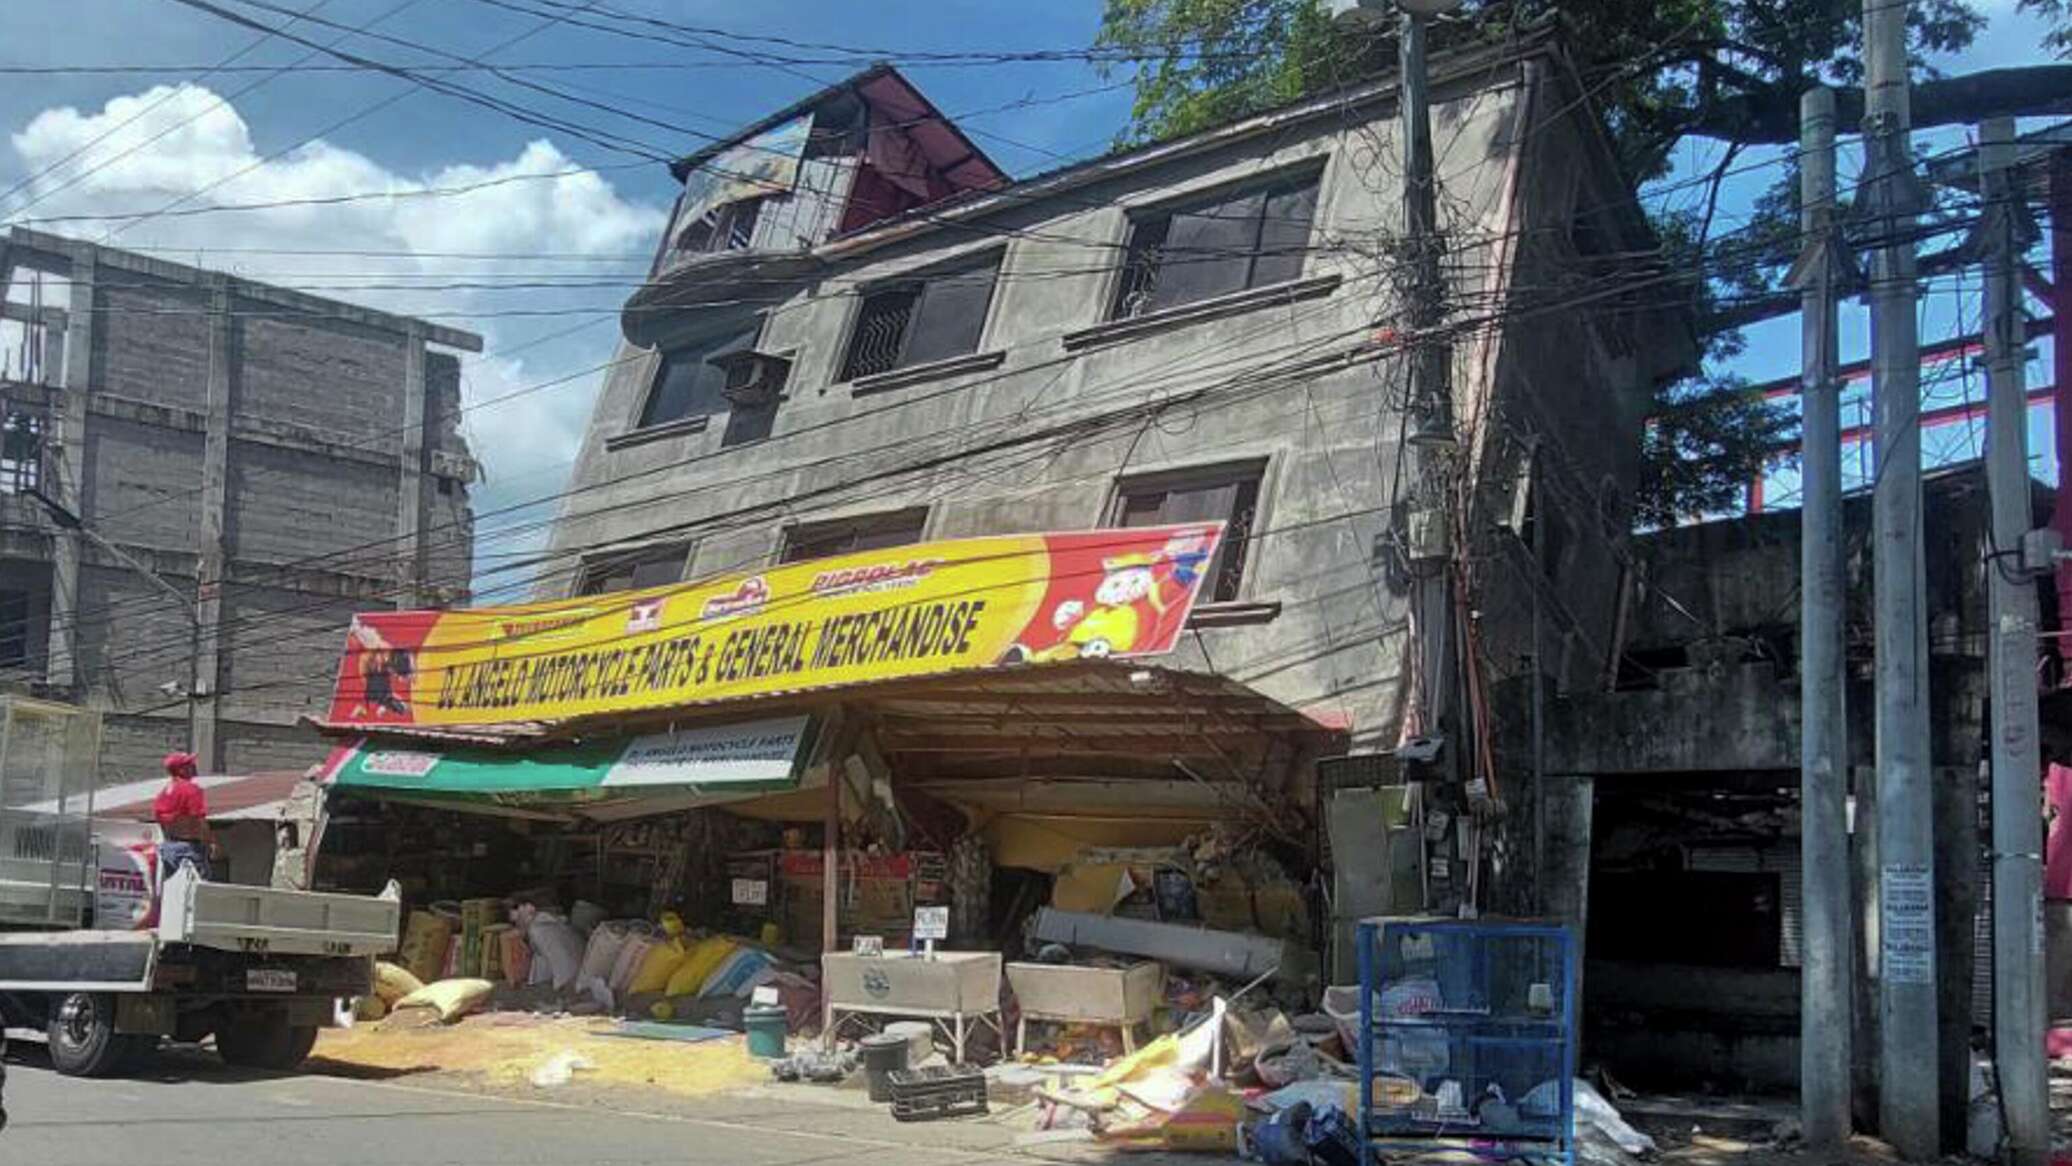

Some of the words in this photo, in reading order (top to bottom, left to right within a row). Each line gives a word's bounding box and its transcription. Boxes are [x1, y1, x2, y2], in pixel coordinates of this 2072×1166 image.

[461, 658, 527, 707] ANGELO
[527, 647, 644, 702] MOTORCYCLE
[634, 634, 700, 690] PARTS
[696, 641, 715, 684] &
[716, 620, 812, 682] GENERAL
[811, 600, 986, 670] MERCHANDISE
